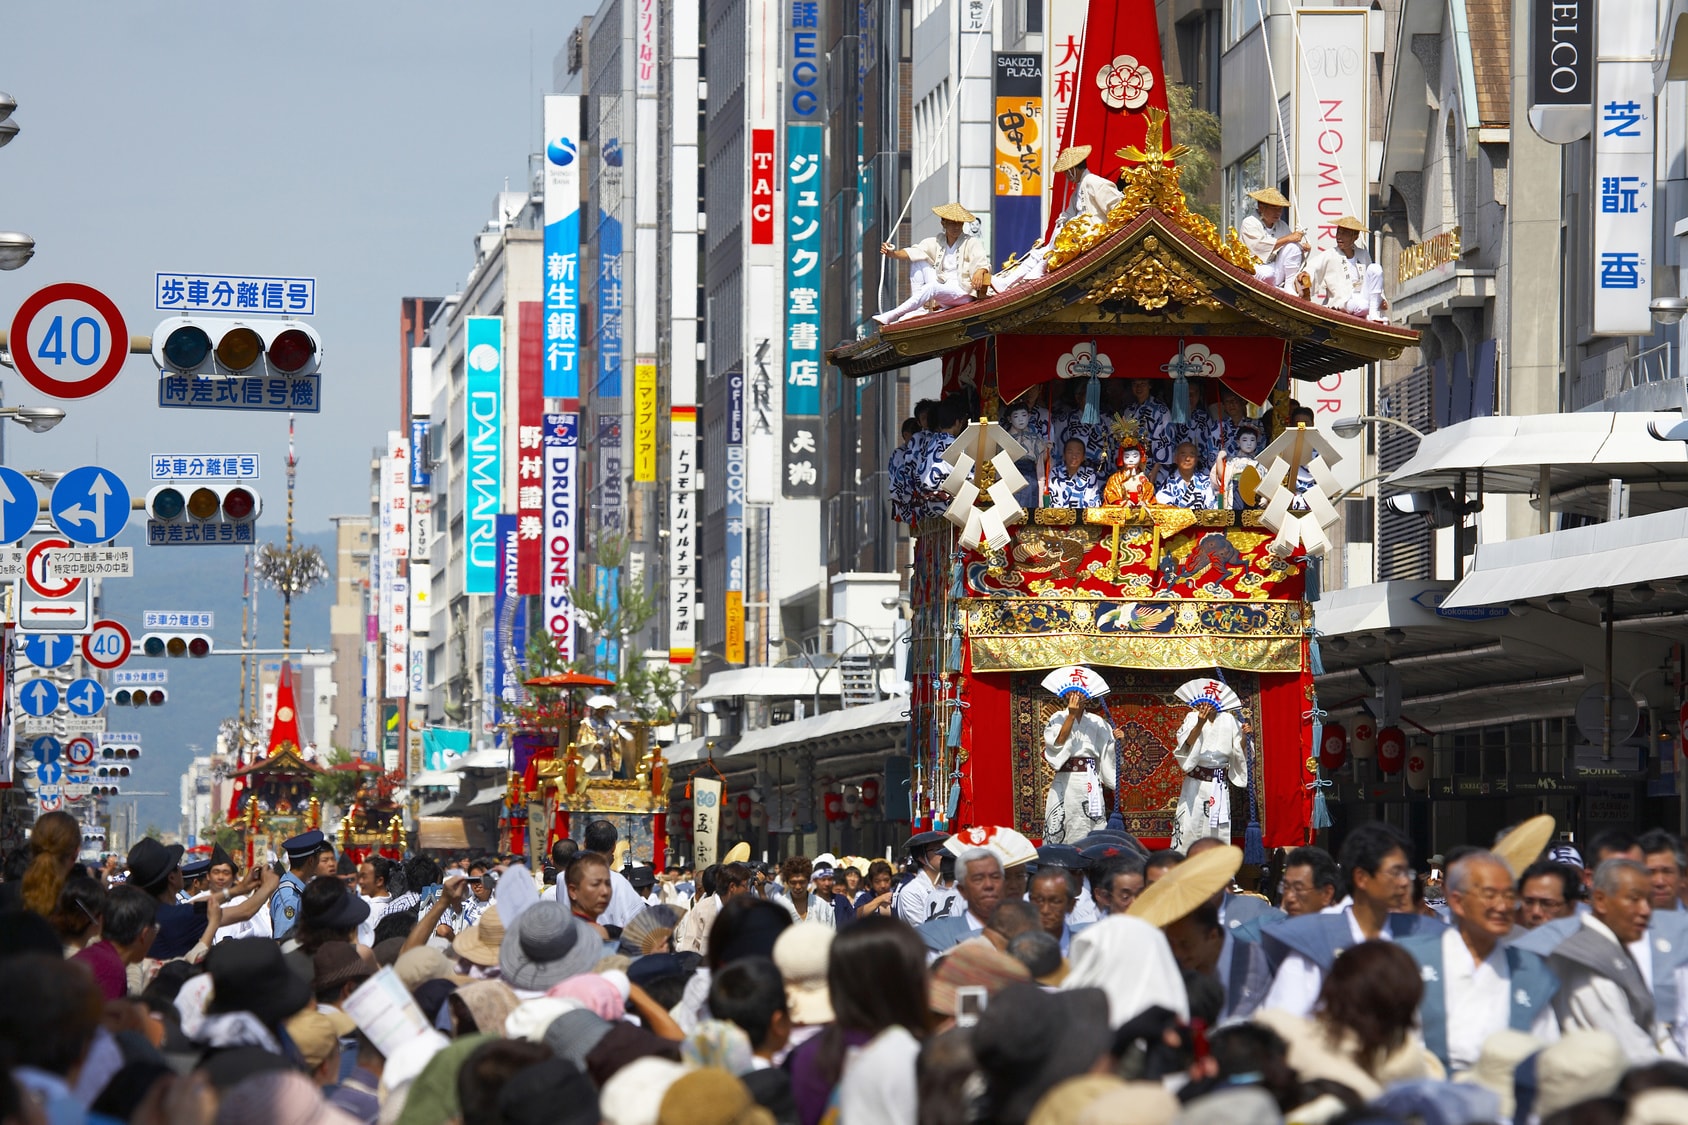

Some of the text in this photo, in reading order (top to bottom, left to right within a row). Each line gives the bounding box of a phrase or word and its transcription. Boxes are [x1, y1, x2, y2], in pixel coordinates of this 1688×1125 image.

[998, 57, 1035, 67] SAKIZO
[1007, 68, 1042, 77] PLAZA
[1026, 102, 1041, 118] 5F
[753, 152, 772, 222] TAC
[789, 153, 819, 387] ジュンク堂書店
[162, 279, 309, 309] 歩車分離信号
[547, 252, 577, 371] 新生銀行
[38, 316, 100, 365] 40
[167, 378, 313, 406] 時差式信号機
[752, 338, 773, 435] ZARA
[155, 459, 255, 476] 歩車分離信号
[727, 447, 743, 504] BOOK
[788, 430, 816, 486] 天狗
[471, 391, 502, 567] DAIMARU
[519, 425, 543, 540] 野村證券
[552, 458, 569, 528] DRUG
[151, 523, 250, 542] 時差式信号機
[54, 564, 129, 574] 特定中型以外の中型
[146, 614, 210, 626] 歩車分離信号
[93, 634, 120, 655] 40
[412, 651, 423, 692] SECOM
